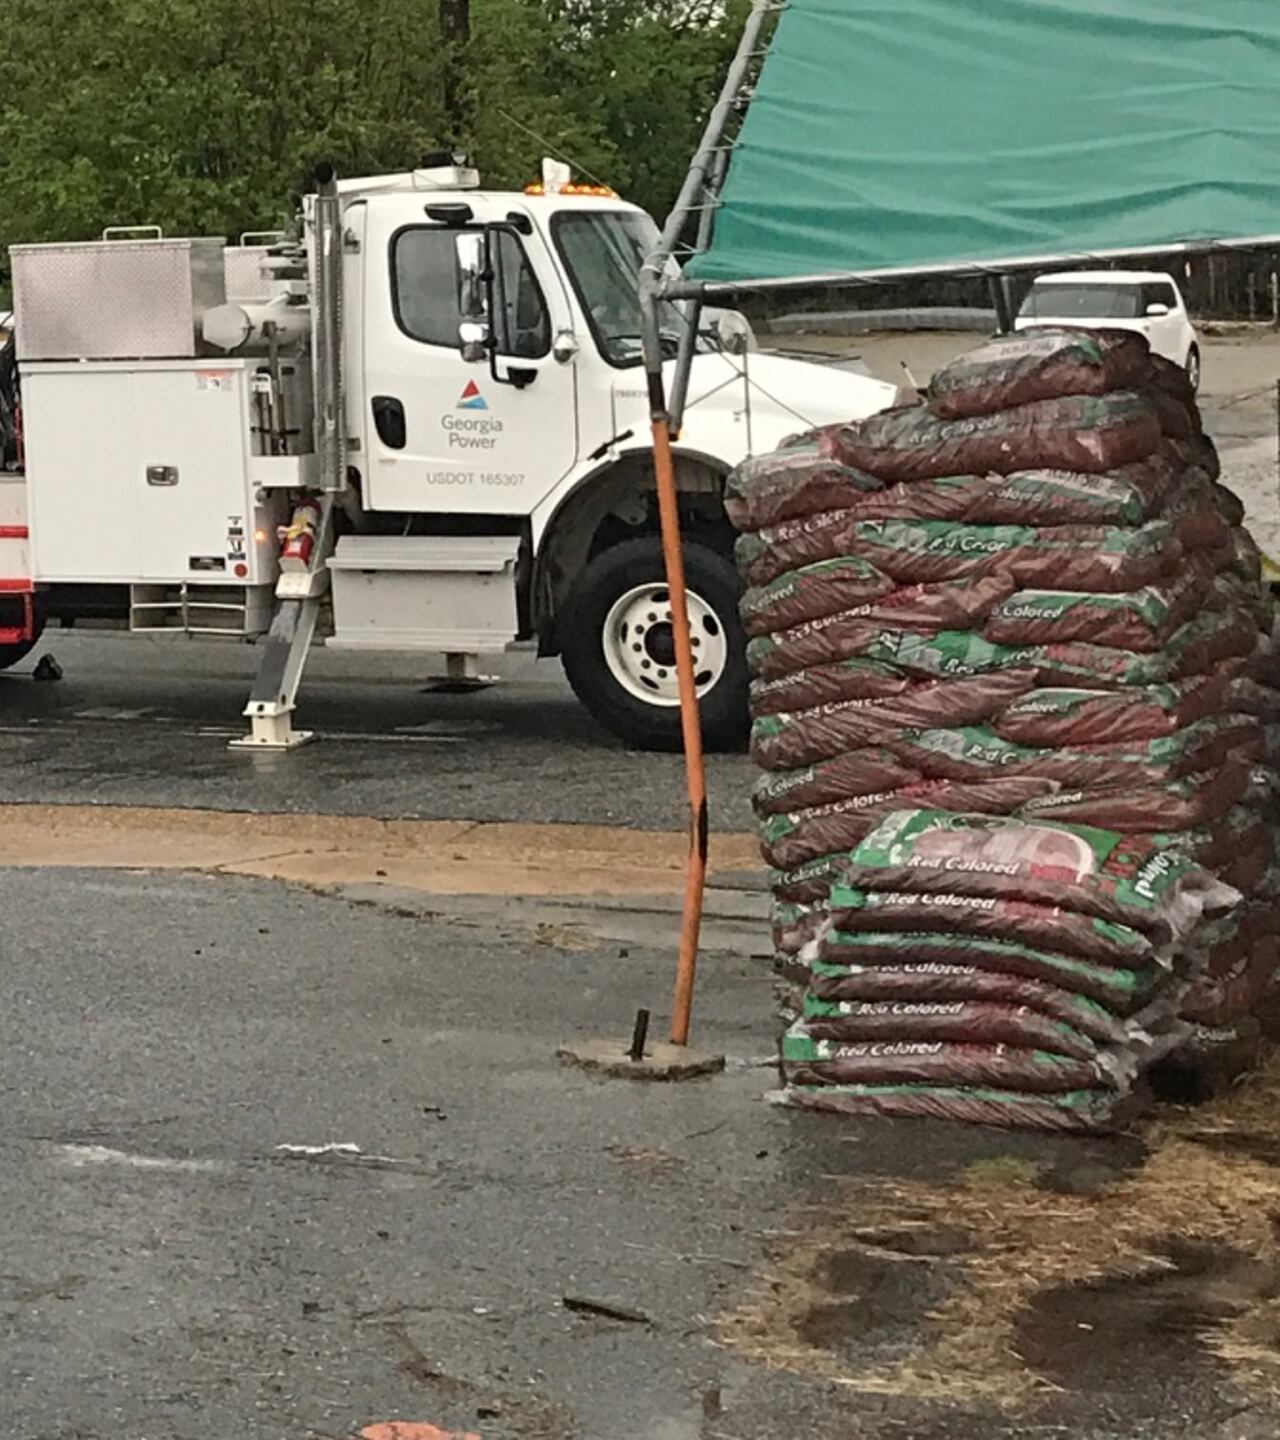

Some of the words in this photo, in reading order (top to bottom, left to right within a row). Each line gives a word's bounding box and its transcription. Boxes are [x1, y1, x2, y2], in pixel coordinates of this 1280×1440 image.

[441, 414, 504, 435] Georgia
[448, 431, 497, 449] Power
[426, 471, 475, 485] USDOT
[1003, 605, 1064, 619] Colored
[907, 854, 940, 869] Red
[944, 856, 1020, 876] Colored
[885, 892, 919, 905] Red
[921, 893, 997, 910] Colored
[892, 1001, 966, 1015] Colored
[836, 1045, 868, 1058] Red
[870, 1041, 944, 1058] Colored
